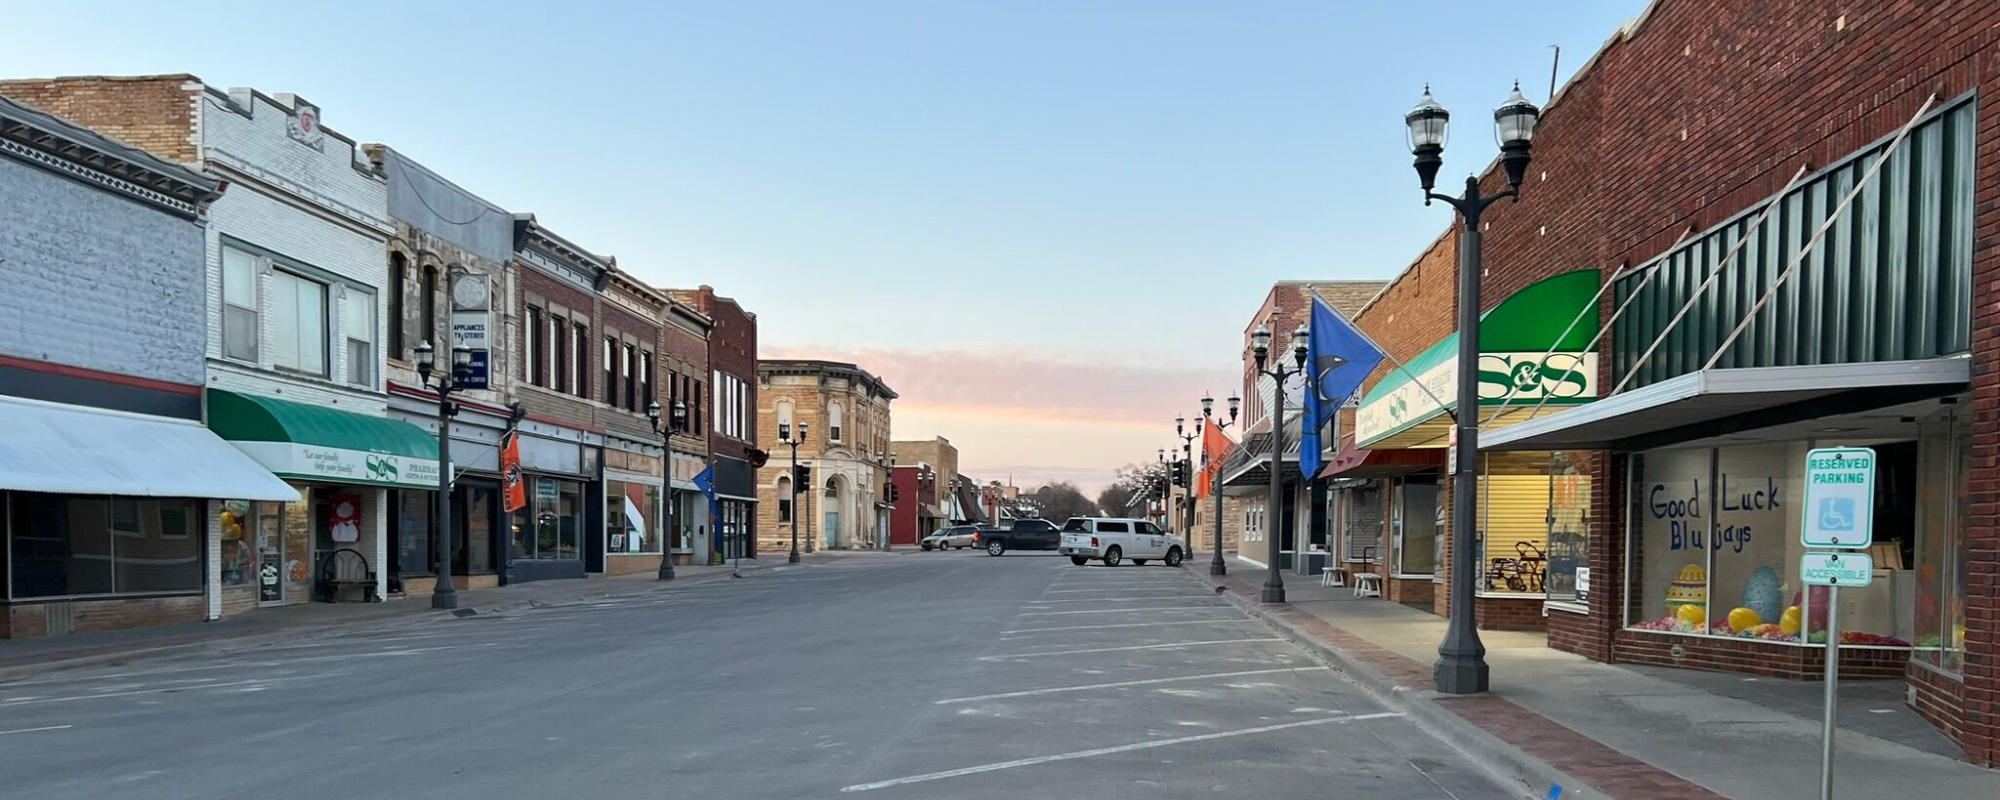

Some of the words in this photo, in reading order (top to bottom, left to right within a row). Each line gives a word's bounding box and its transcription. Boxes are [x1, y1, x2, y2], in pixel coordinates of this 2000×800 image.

[1478, 354, 1587, 399] S&S
[366, 454, 398, 481] S&S
[409, 464, 438, 474] PHARMAC
[1810, 458, 1869, 470] RESERVED
[1813, 473, 1864, 484] PARKING
[1650, 479, 1701, 519] Good
[1722, 473, 1780, 511] Luck
[1825, 559, 1845, 569] VAN
[1806, 569, 1866, 580] ACCESSIBLE
